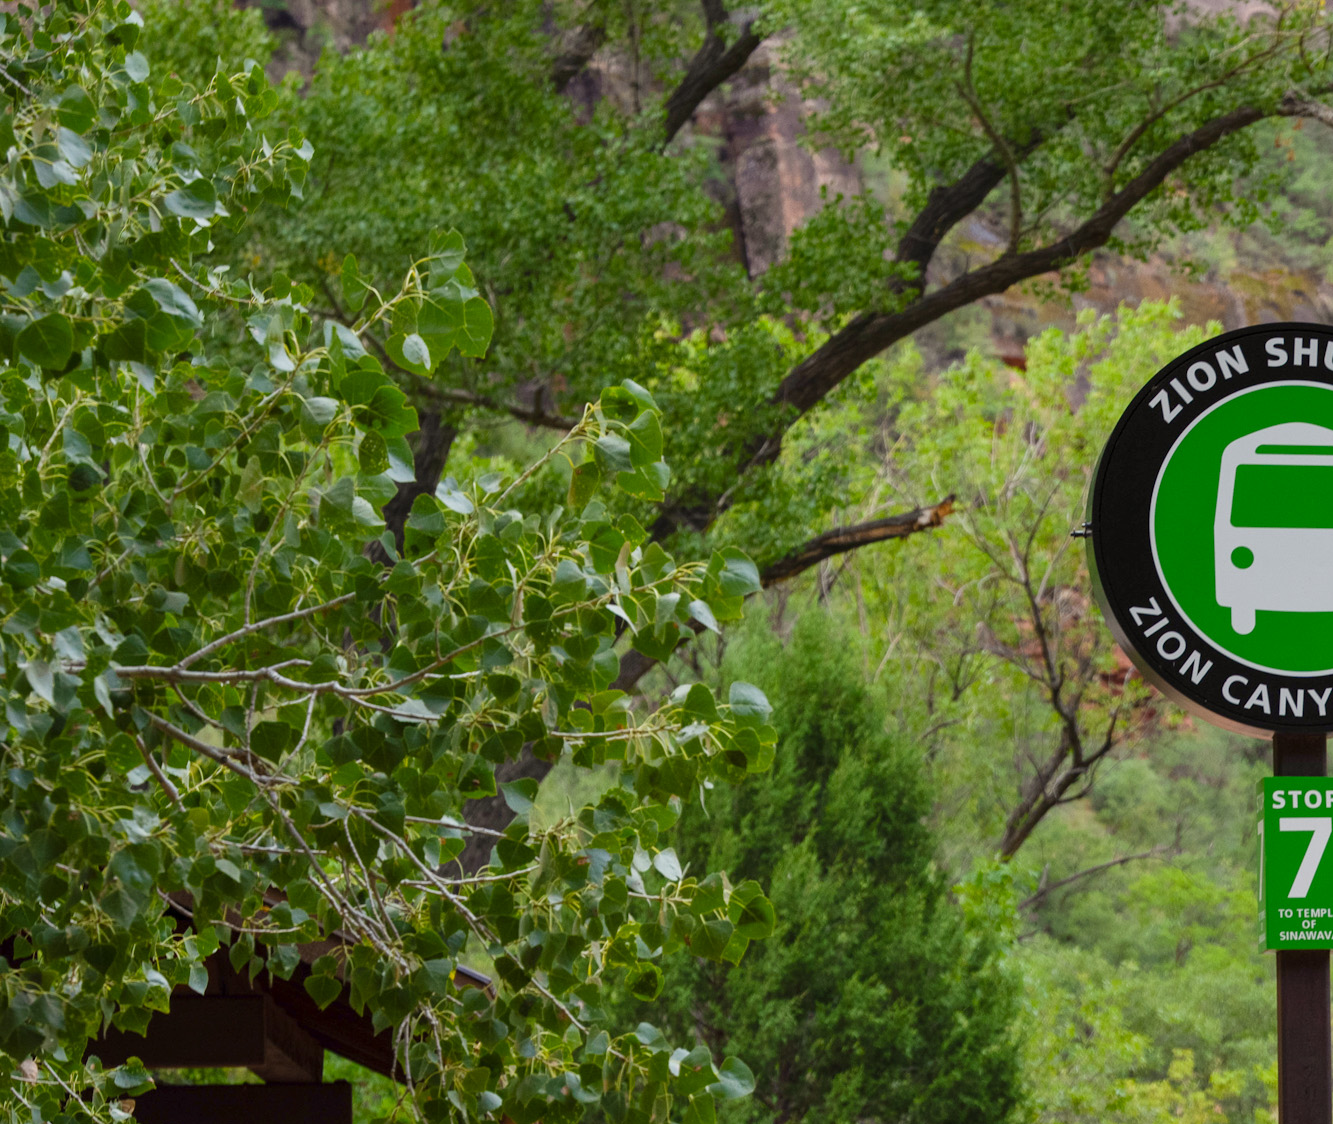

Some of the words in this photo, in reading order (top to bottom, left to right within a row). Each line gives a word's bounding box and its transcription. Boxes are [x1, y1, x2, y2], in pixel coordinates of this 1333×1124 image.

[1148, 344, 1249, 424] ZION
[1129, 596, 1214, 685] ZION
[1279, 817, 1333, 899] 7
[1278, 908, 1294, 918] TO
[1302, 919, 1317, 929] OF
